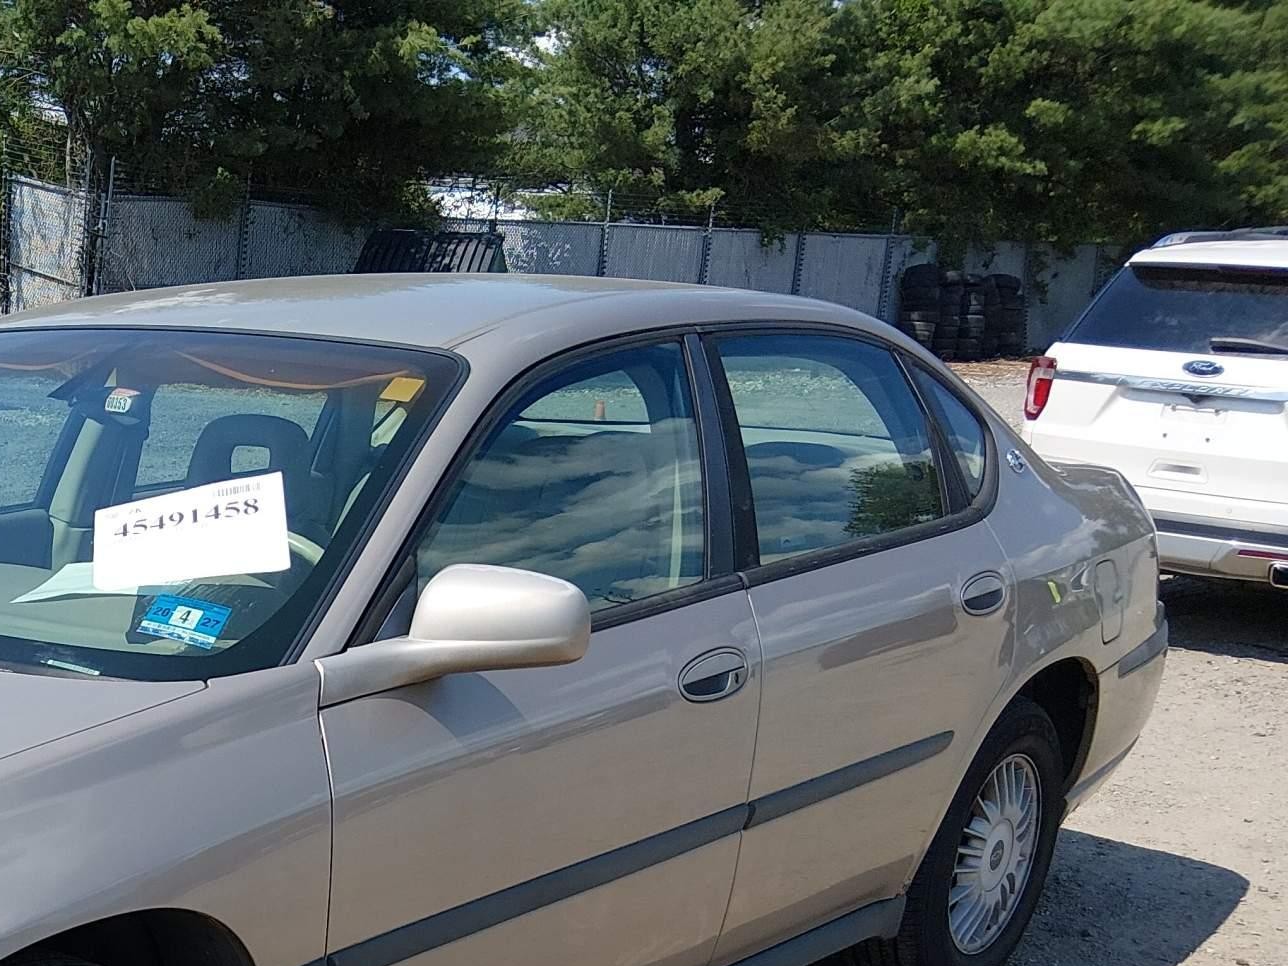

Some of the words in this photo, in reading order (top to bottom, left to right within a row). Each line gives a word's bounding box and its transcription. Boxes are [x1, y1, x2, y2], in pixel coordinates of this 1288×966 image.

[114, 499, 259, 537] 45491458
[153, 606, 171, 617] 20
[179, 610, 193, 624] 4
[200, 617, 220, 628] 27
